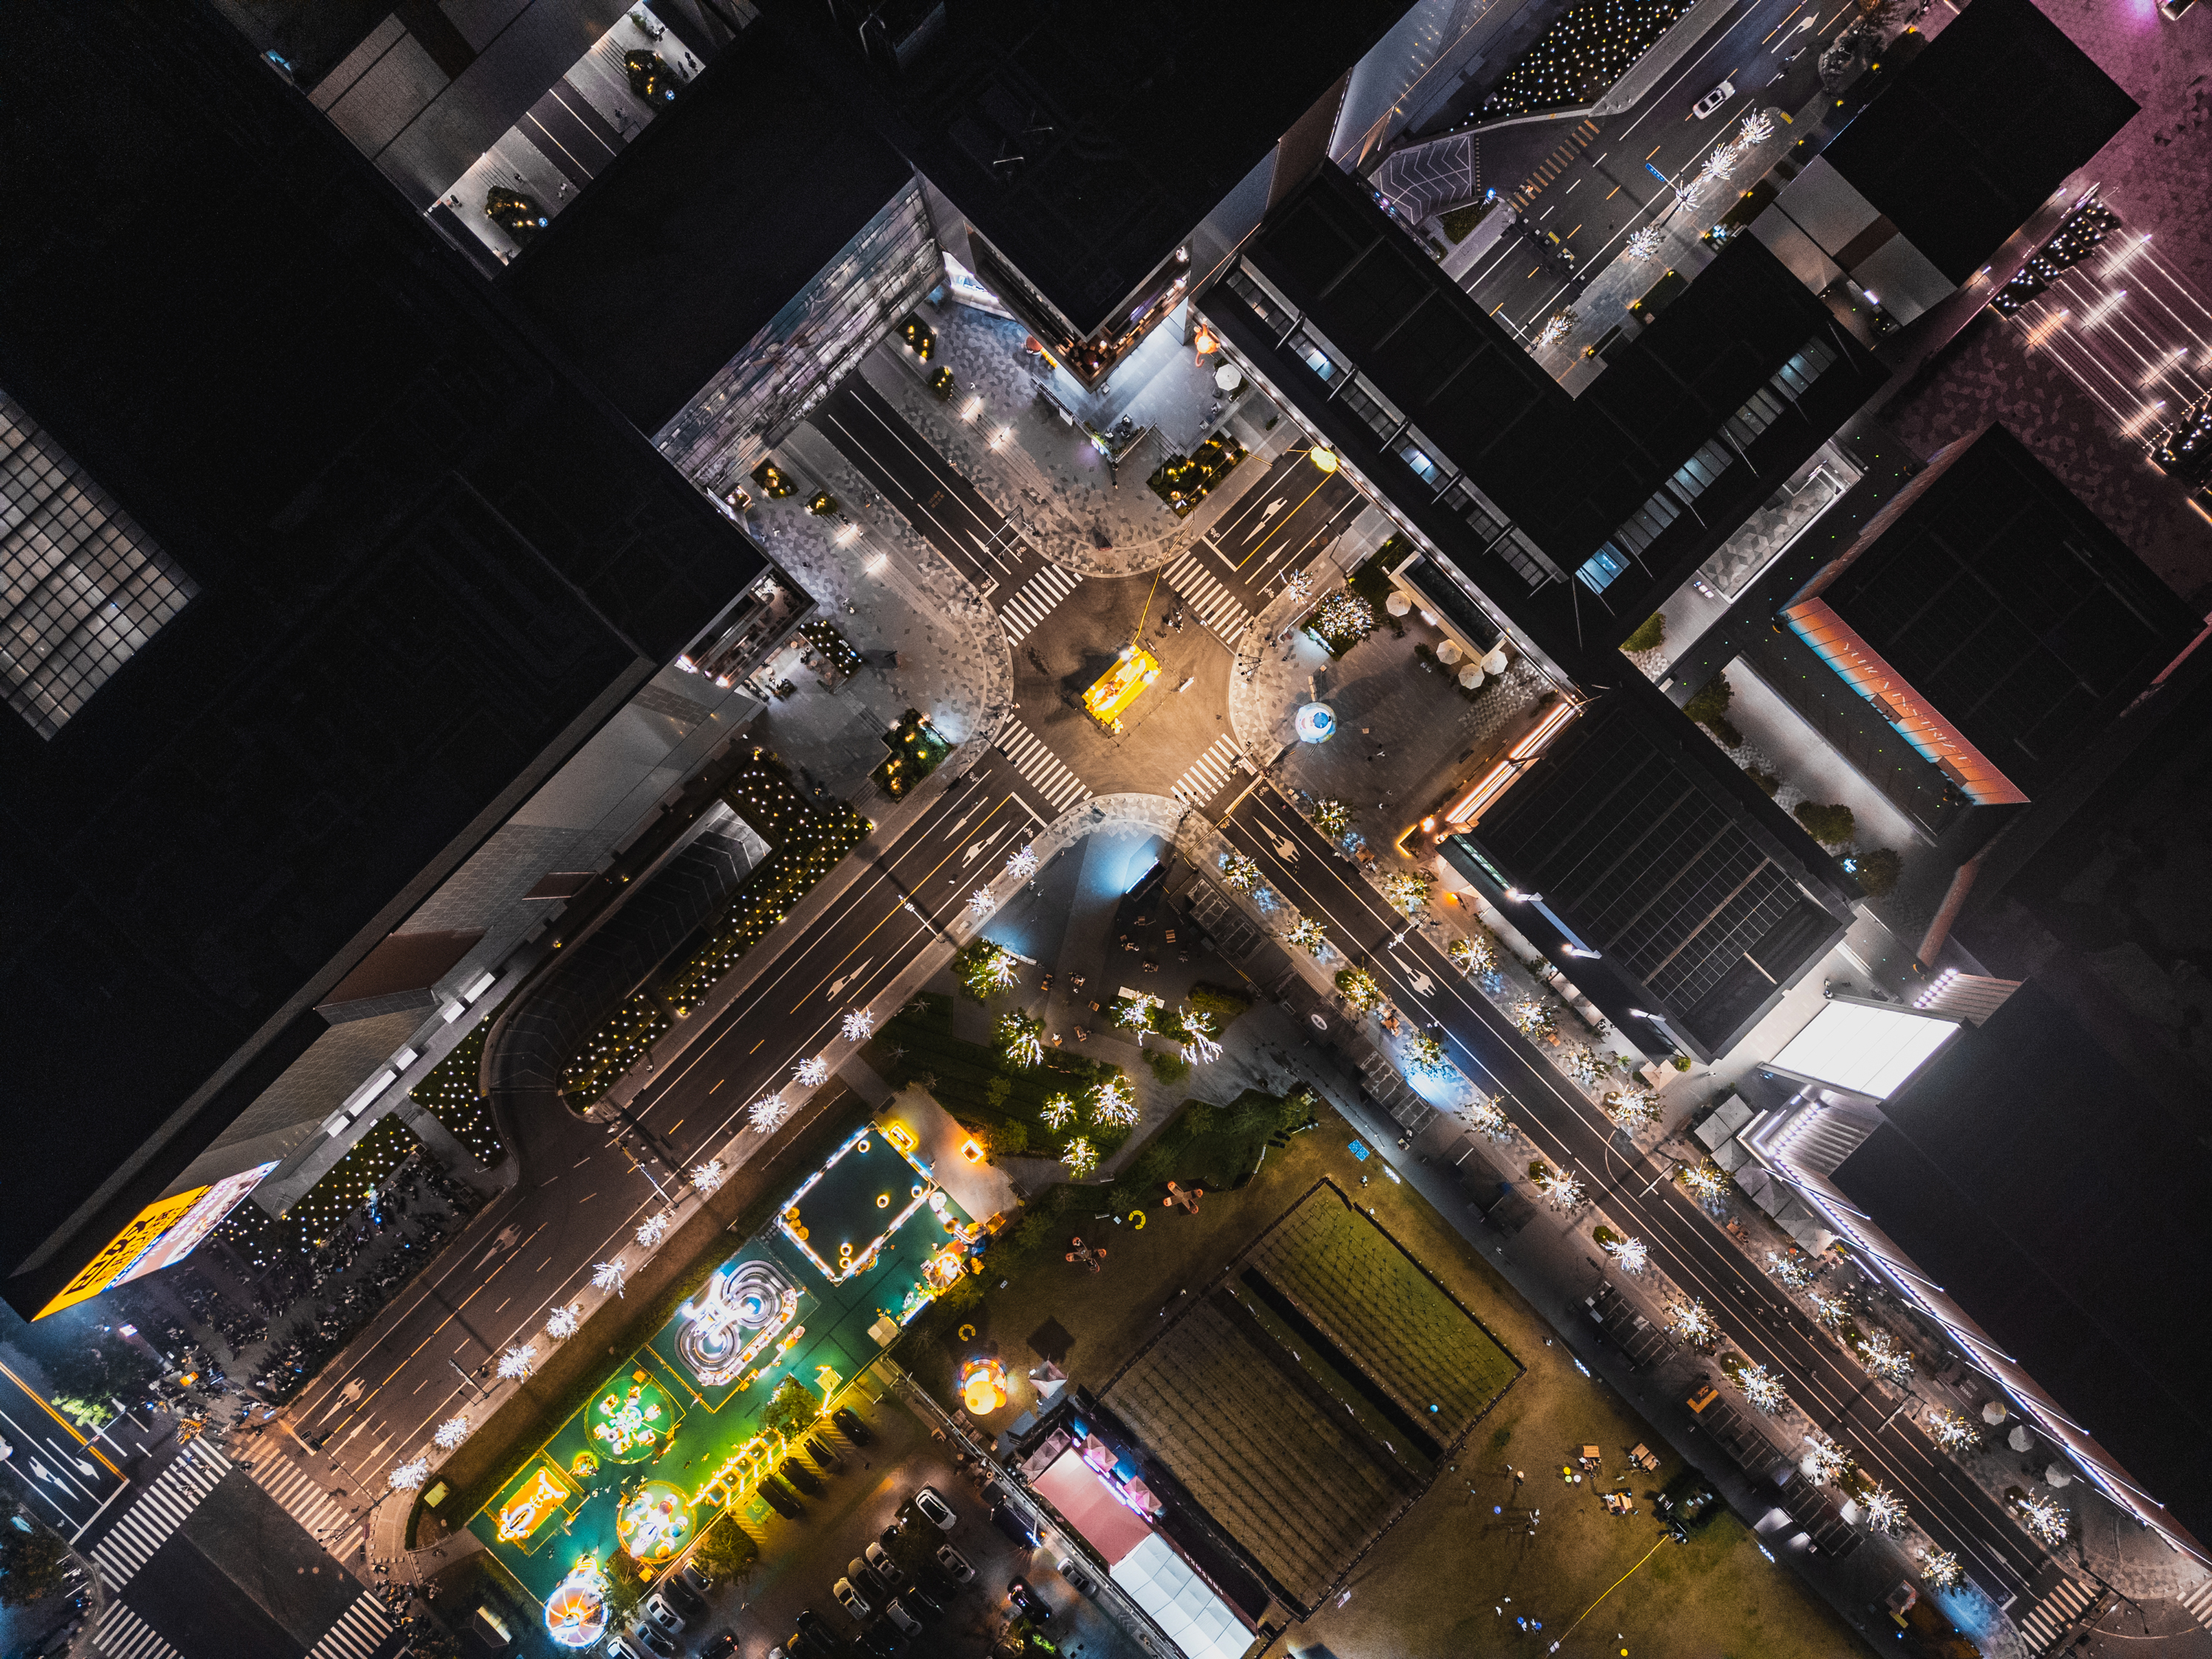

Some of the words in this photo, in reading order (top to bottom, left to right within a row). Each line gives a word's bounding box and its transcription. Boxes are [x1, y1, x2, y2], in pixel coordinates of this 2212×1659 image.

[63, 1215, 156, 1296] 巴奴
[90, 1208, 175, 1285] 毛肚火锅
[1959, 1384, 1972, 1399] TENNIS
[1966, 1380, 1978, 1391] DOME
